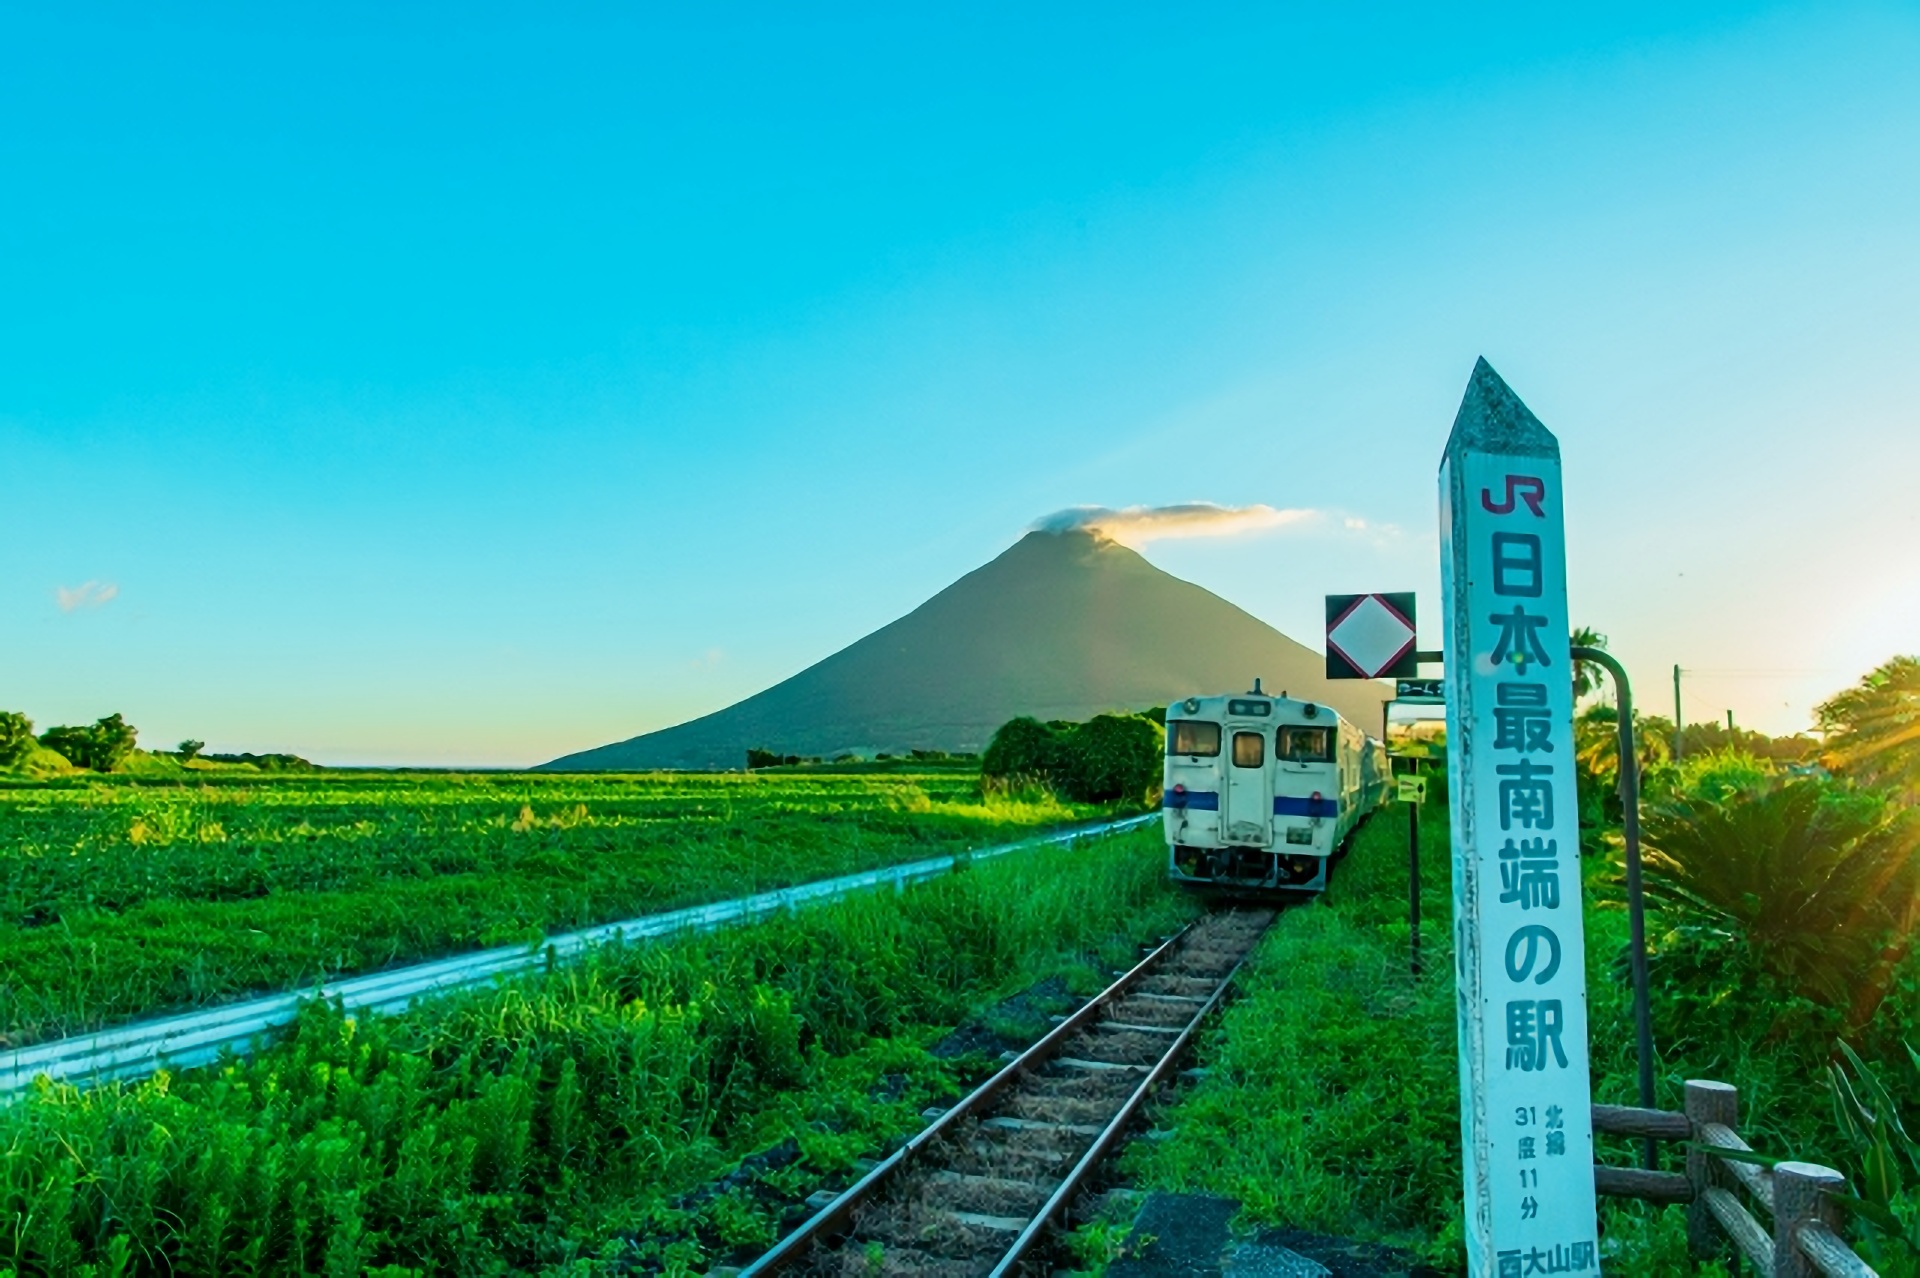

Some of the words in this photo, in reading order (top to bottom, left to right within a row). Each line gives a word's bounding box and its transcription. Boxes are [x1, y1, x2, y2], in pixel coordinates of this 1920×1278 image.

[1481, 474, 1546, 518] JR
[1489, 531, 1568, 1072] 日本最南端の駅
[1545, 1104, 1565, 1156] 北
[1497, 1241, 1596, 1278] 西大山駅
